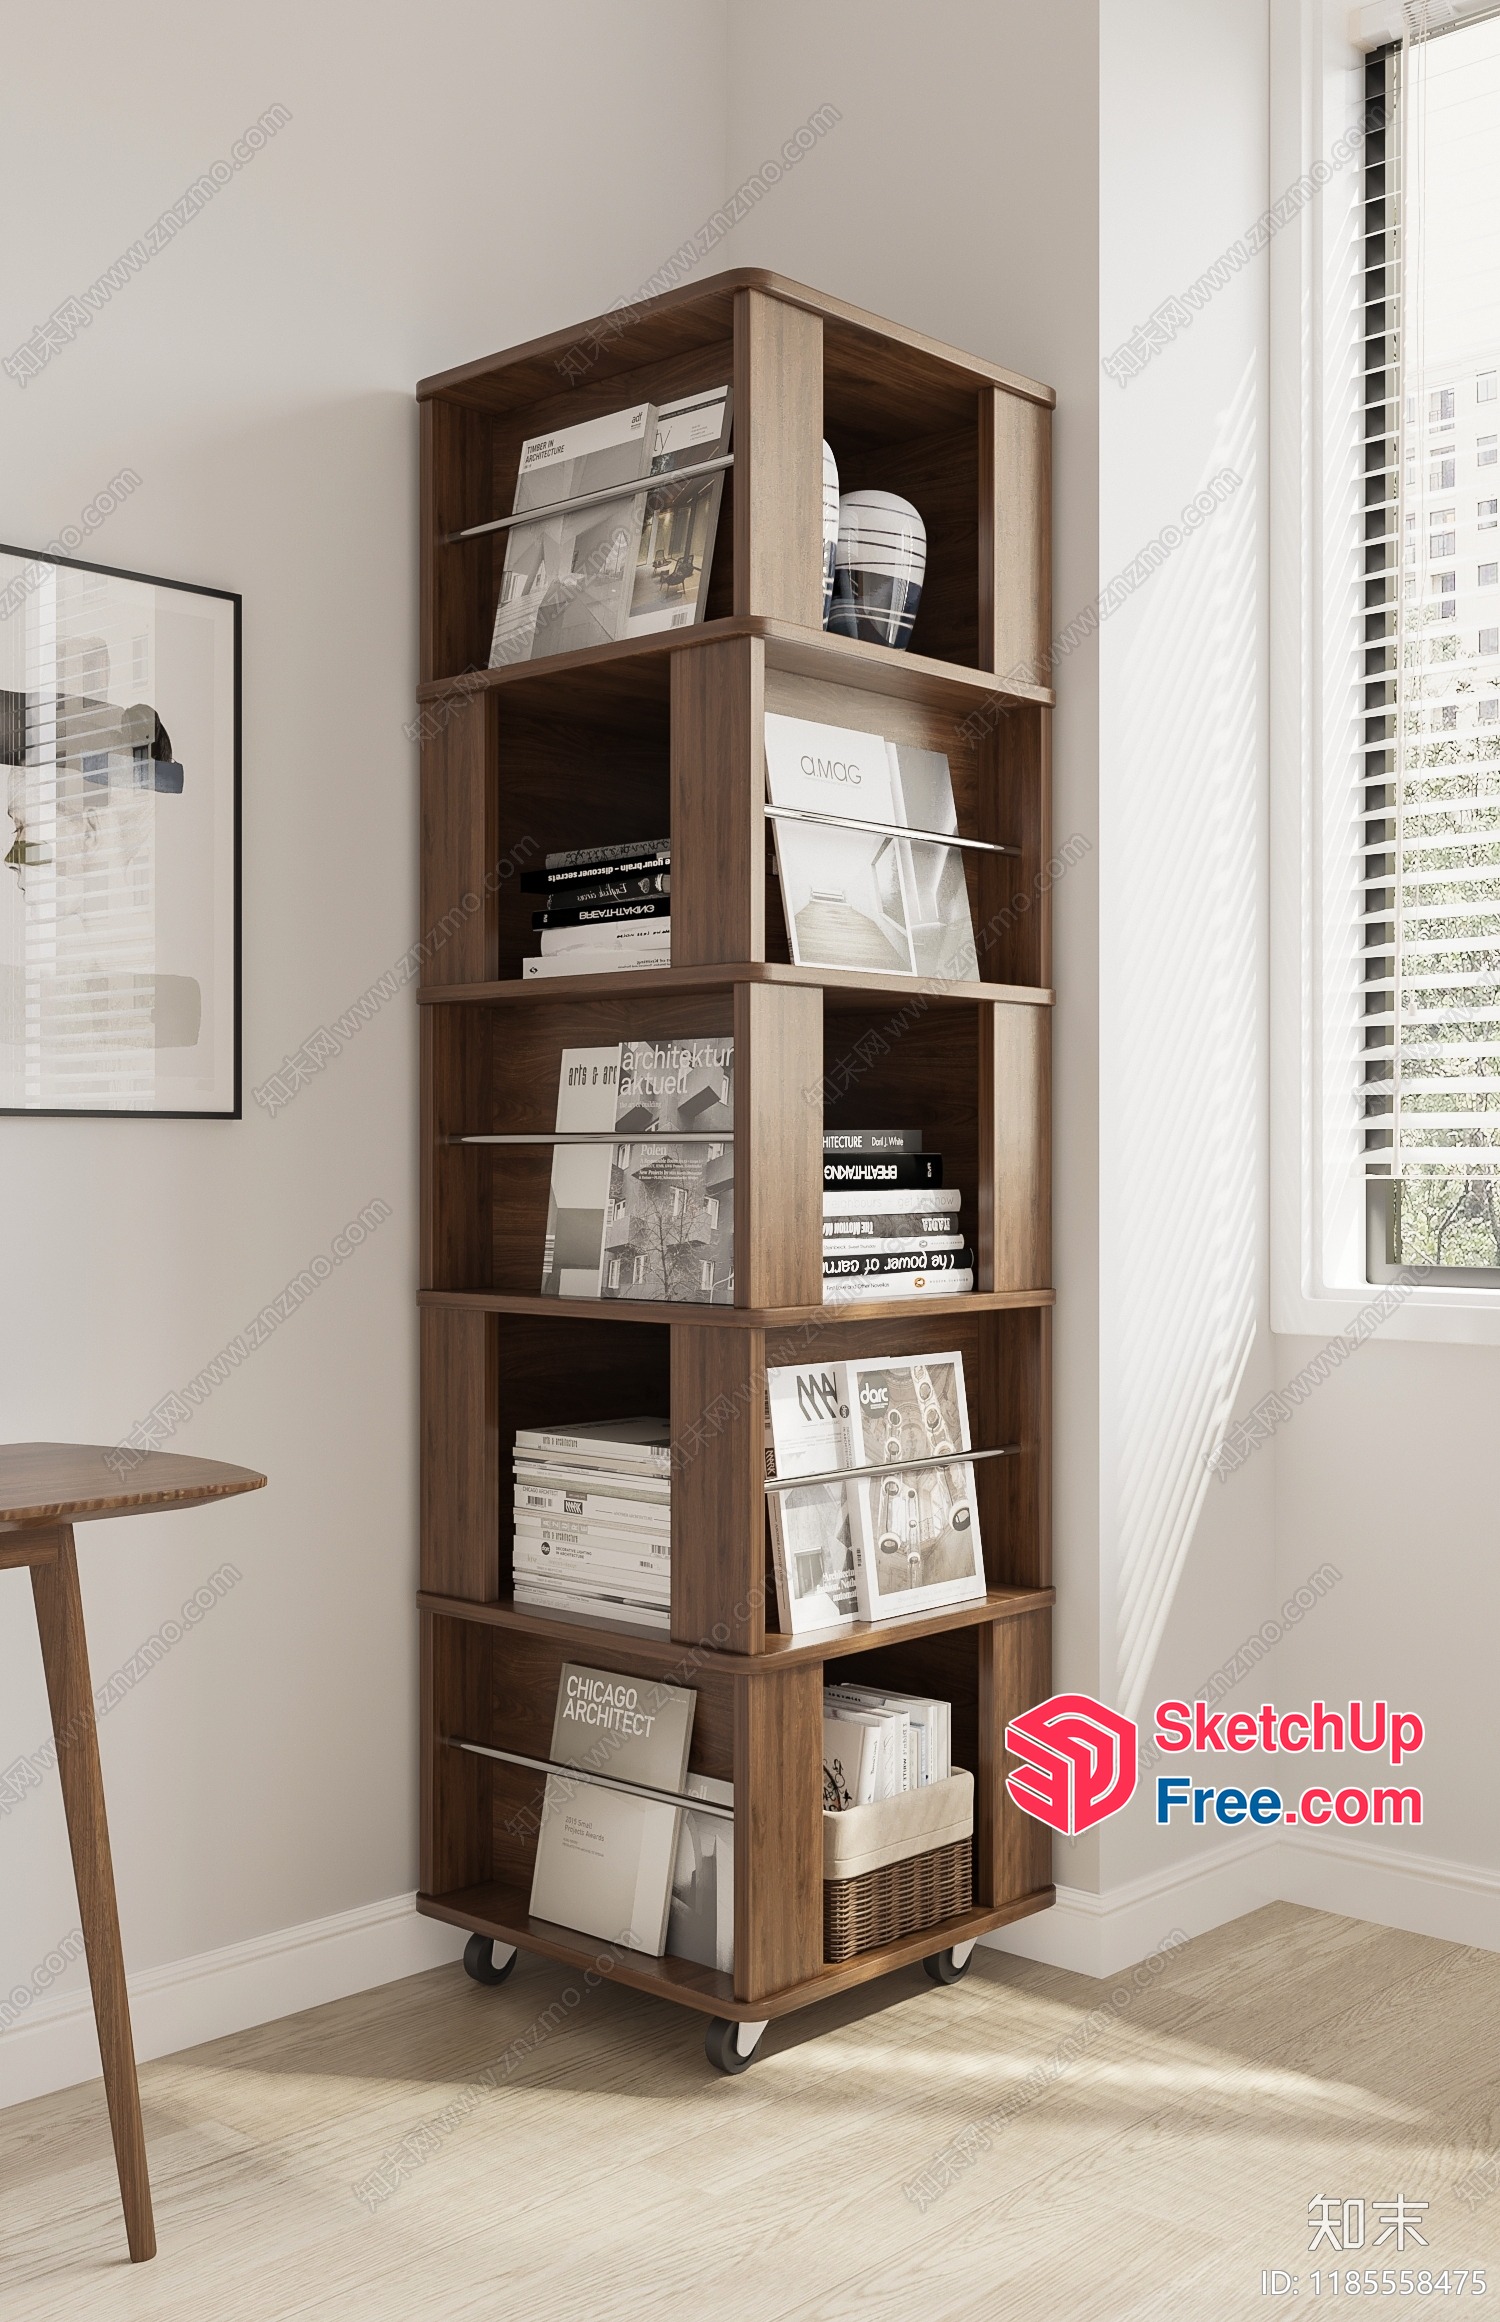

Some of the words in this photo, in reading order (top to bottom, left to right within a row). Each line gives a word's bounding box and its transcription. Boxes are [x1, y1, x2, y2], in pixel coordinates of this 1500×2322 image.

[525, 444, 565, 463] ARCHITECTURE
[527, 441, 547, 454] TIMBER
[547, 439, 555, 448] IN
[620, 861, 643, 871] brain
[643, 857, 664, 868] your
[547, 871, 578, 882] secrets
[578, 866, 613, 878] discover
[622, 1043, 735, 1070] architektur
[568, 1064, 588, 1086] arts
[592, 1066, 599, 1085] &
[619, 1070, 688, 1096] aktuell
[889, 1136, 904, 1146] White
[640, 1143, 668, 1156] Polen
[824, 1165, 897, 1180] BREATHTAKING
[864, 1259, 880, 1277] of
[884, 1250, 927, 1270] power
[860, 1382, 889, 1404] darc
[765, 1449, 777, 1477] MARK
[538, 1488, 559, 1497] ARCHITECT
[559, 1551, 585, 1559] ARCHITECTURE
[567, 1675, 638, 1710] CHICAGO
[562, 1698, 656, 1737] ARCHITECT
[577, 1819, 593, 1830] Small
[564, 1824, 585, 1836] Projects
[585, 1830, 605, 1842] Awards
